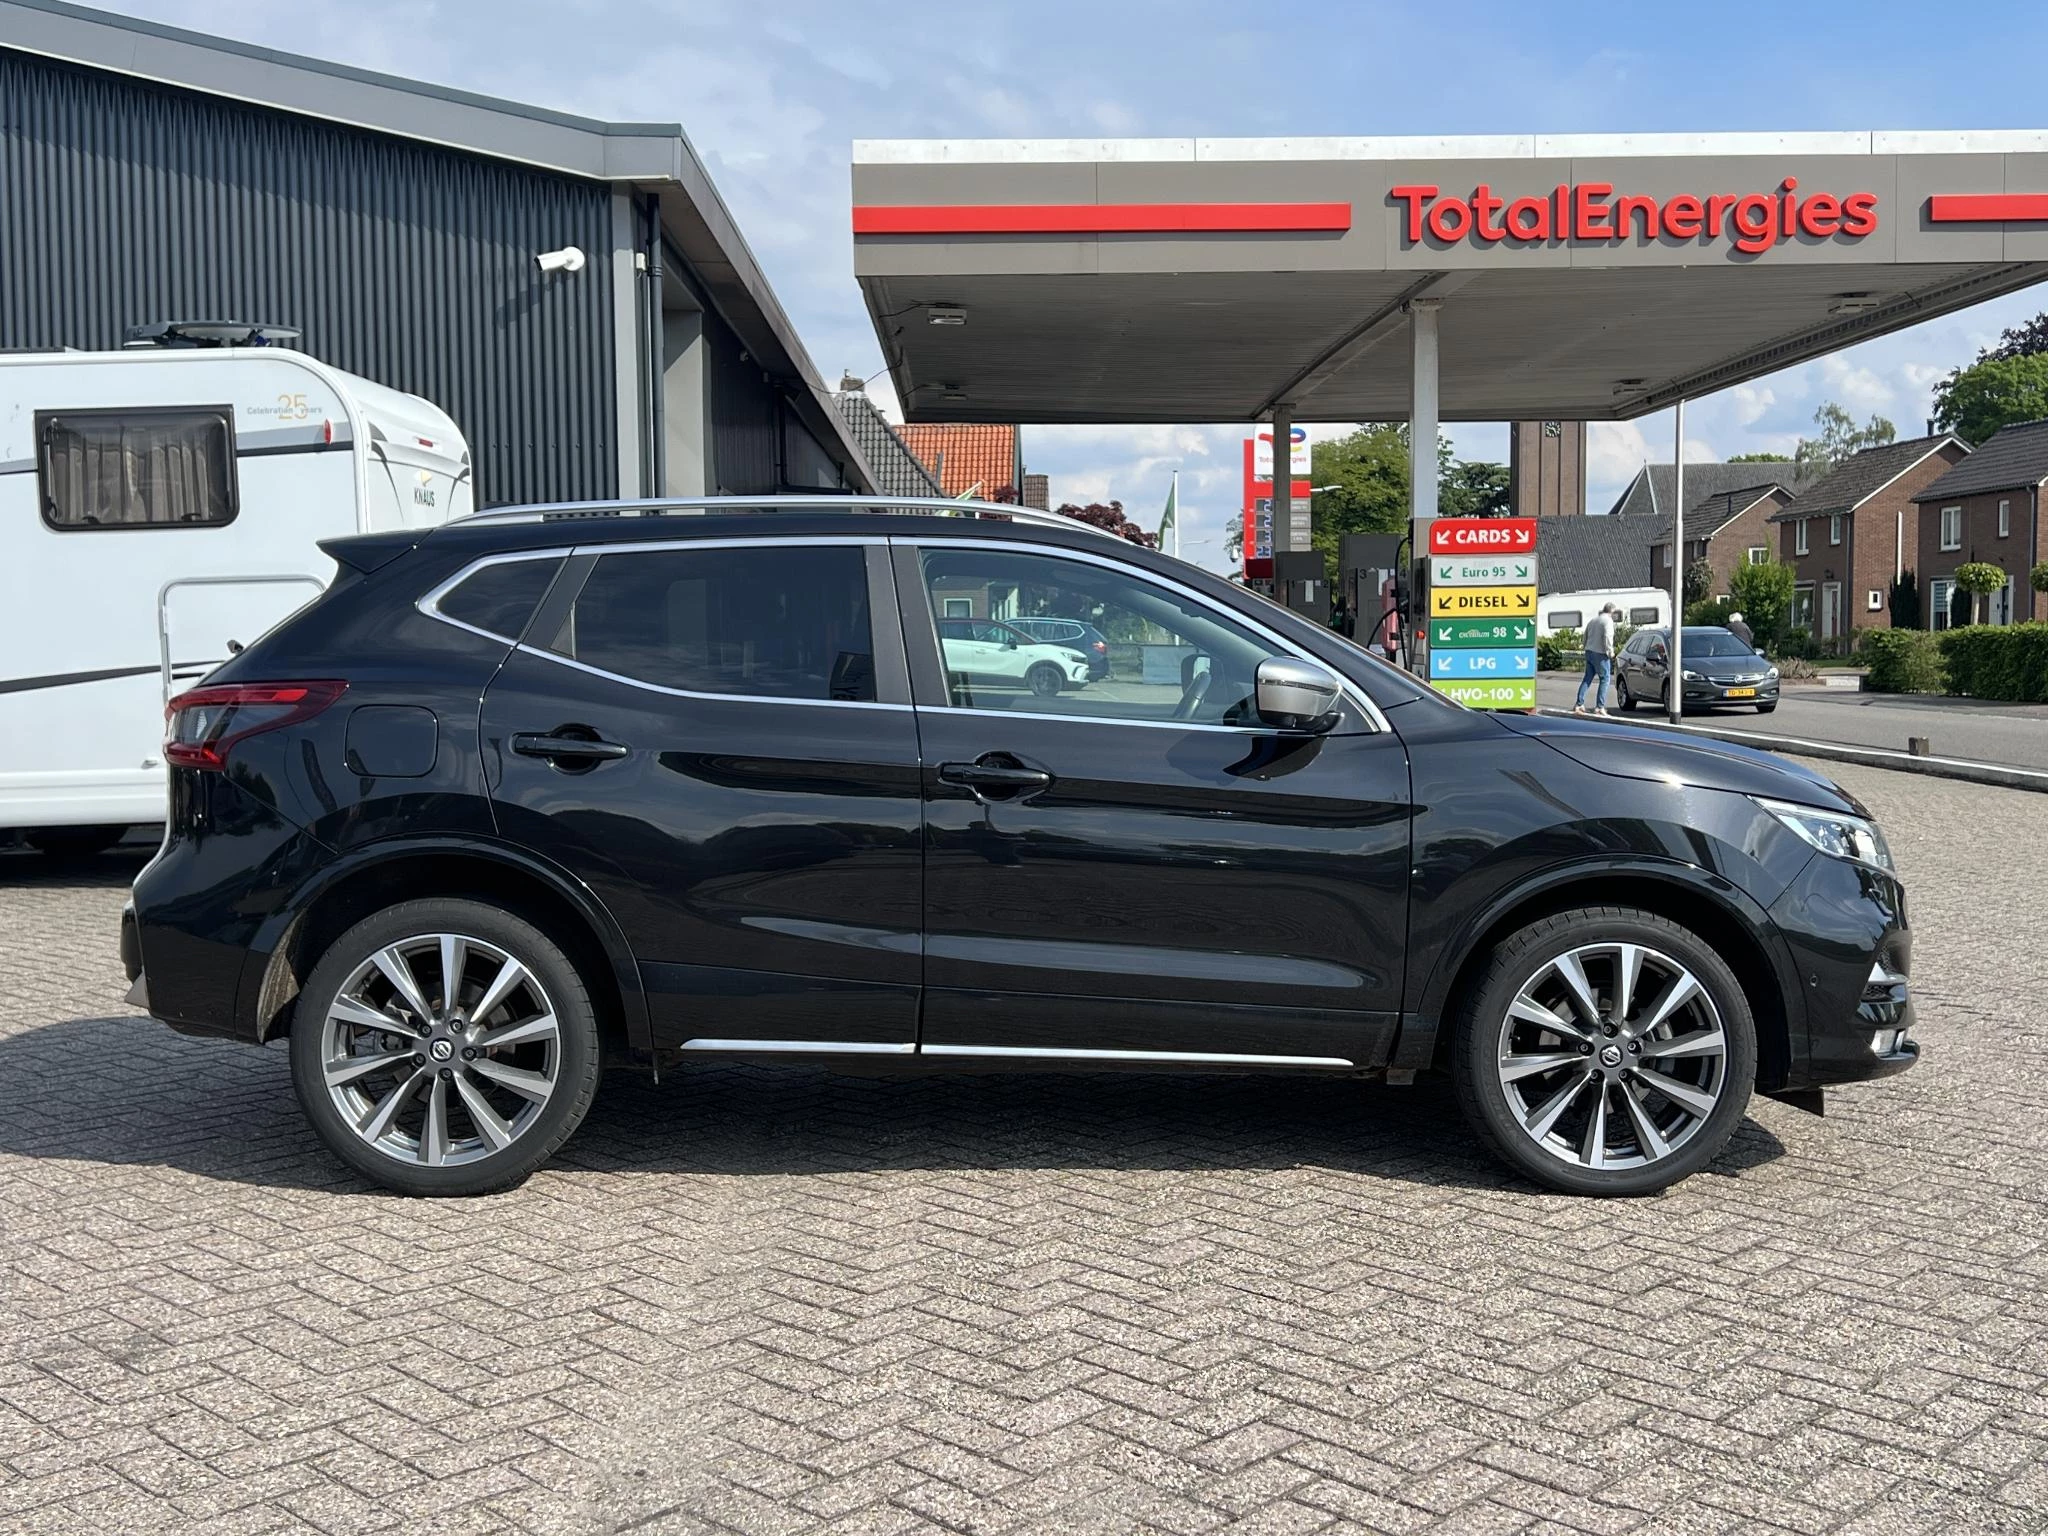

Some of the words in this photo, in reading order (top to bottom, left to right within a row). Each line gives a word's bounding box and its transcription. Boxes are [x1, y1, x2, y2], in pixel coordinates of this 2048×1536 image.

[1391, 176, 1878, 253] TotalEnergies
[247, 407, 293, 415] Celebration
[278, 394, 307, 419] 25
[413, 486, 435, 508] KNAUS
[1455, 529, 1511, 544] CARDS
[1359, 568, 1367, 579] 3
[1462, 567, 1488, 578] Euro
[1492, 566, 1506, 577] 95
[1458, 596, 1508, 608] DIESEL
[1492, 626, 1507, 638] 98
[1469, 657, 1497, 670] LPG
[1450, 687, 1514, 701] HVO-100
